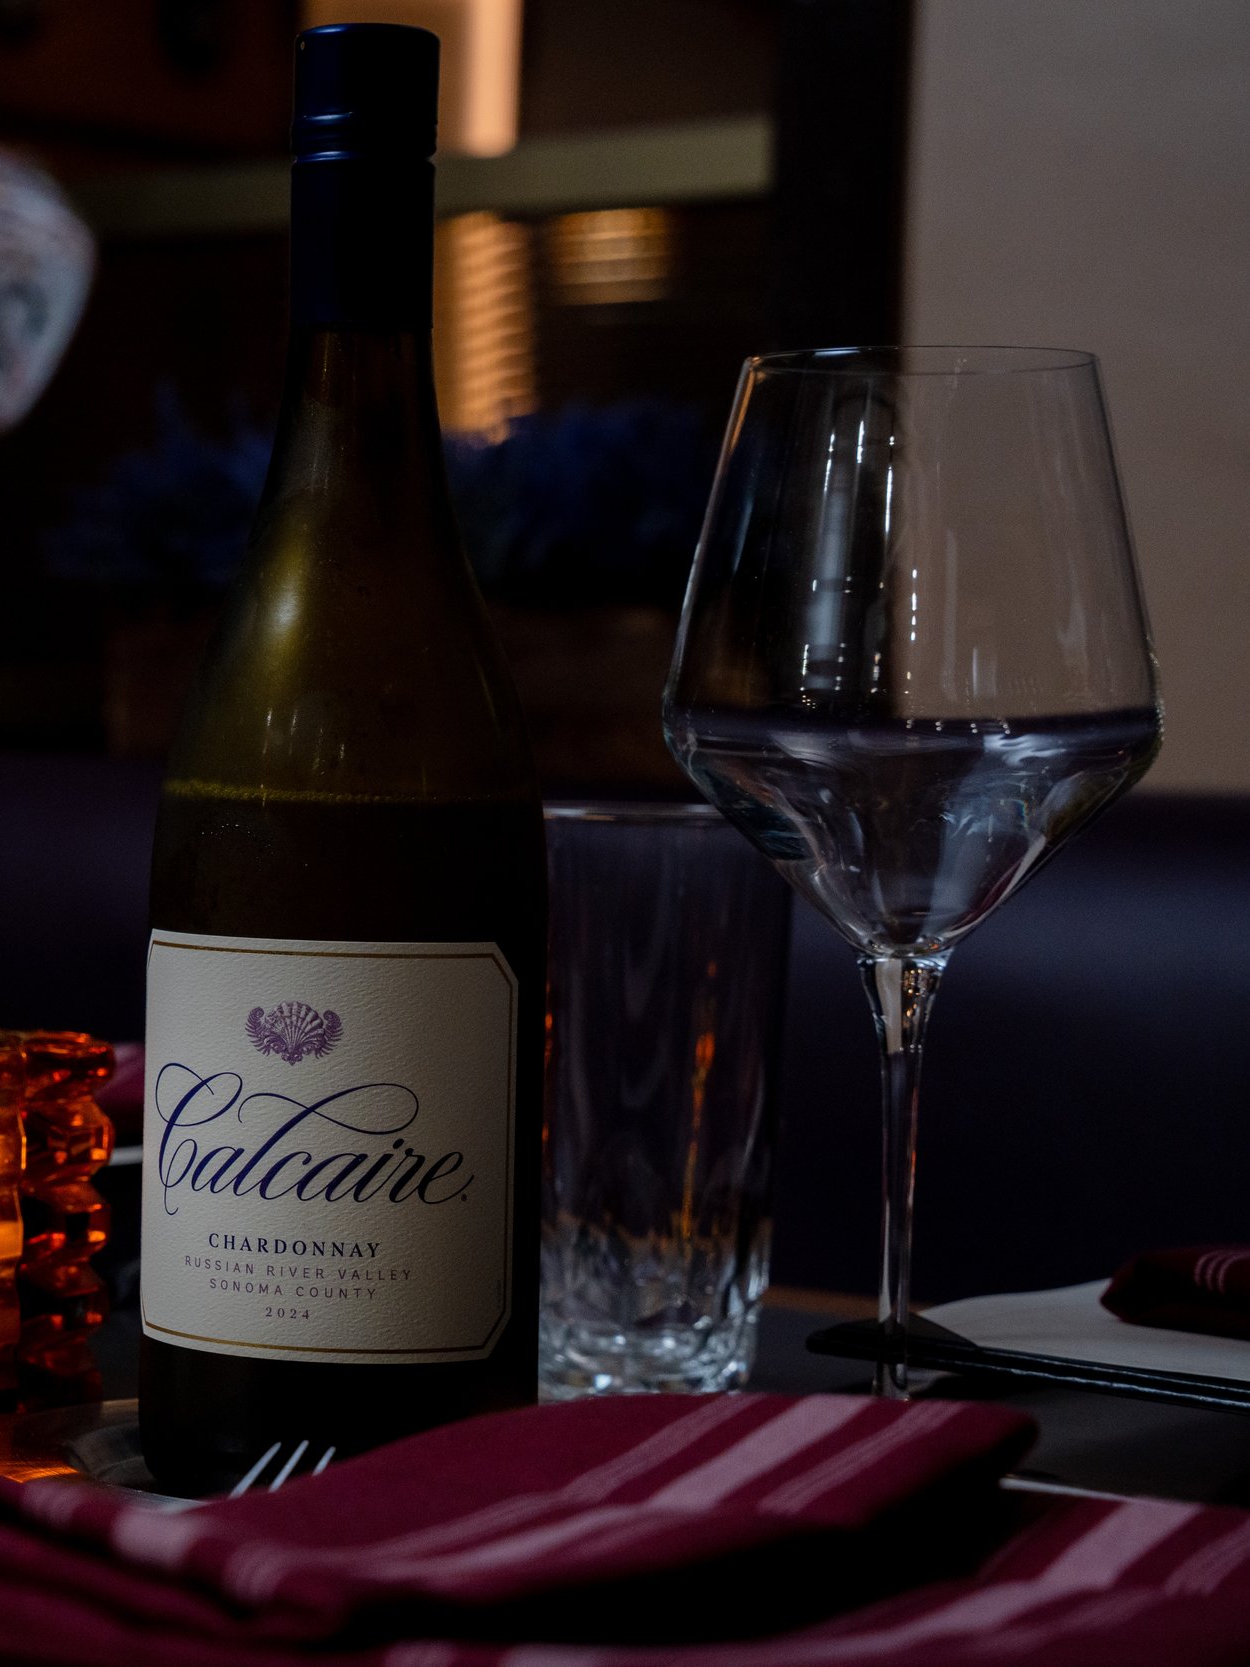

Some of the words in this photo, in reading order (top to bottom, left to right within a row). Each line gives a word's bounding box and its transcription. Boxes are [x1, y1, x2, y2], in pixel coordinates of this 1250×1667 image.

[208, 1232, 380, 1258] CHARDONNAY
[184, 1255, 255, 1275] RUSSIAN
[266, 1265, 325, 1280] RIVER
[338, 1269, 411, 1281] VALLEY
[209, 1278, 283, 1296] SONOMA
[295, 1286, 376, 1299] COUNTY
[265, 1306, 310, 1320] 2024
